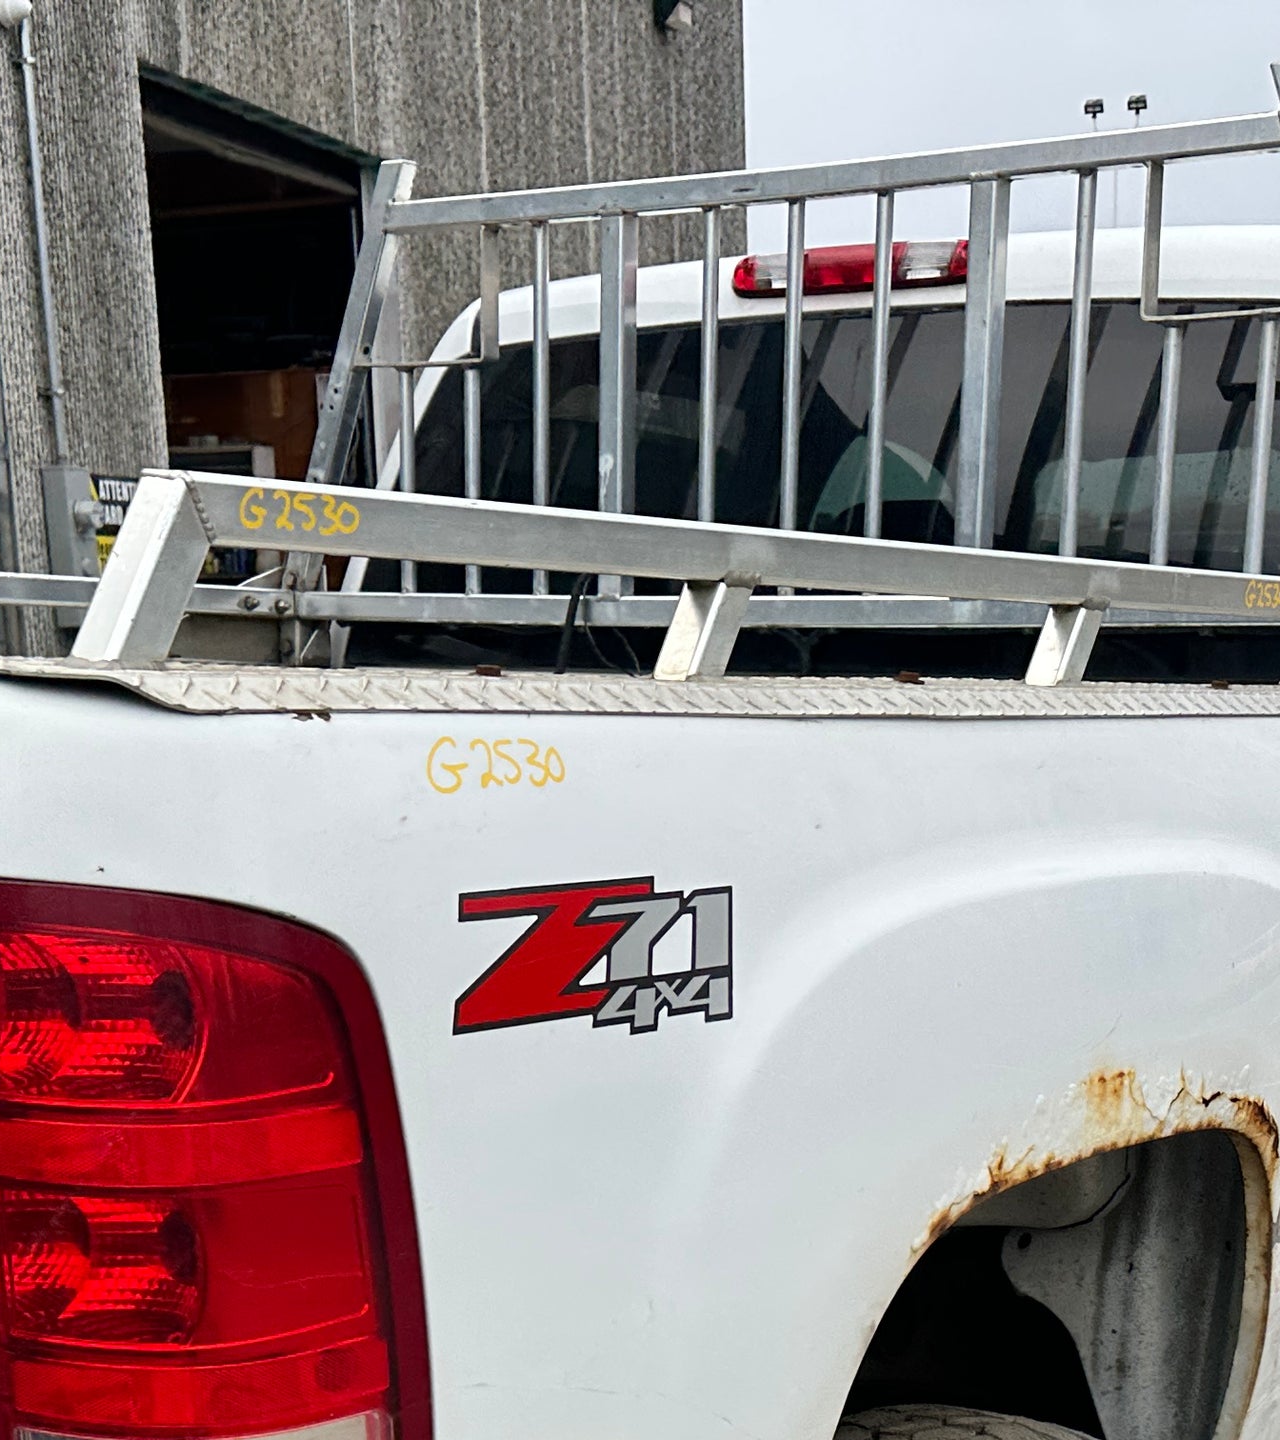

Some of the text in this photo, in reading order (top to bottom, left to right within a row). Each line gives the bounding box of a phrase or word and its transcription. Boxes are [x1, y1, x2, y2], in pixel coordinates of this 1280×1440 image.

[240, 487, 361, 535] G2530
[427, 737, 565, 793] G2530
[453, 876, 733, 1035] Z71
